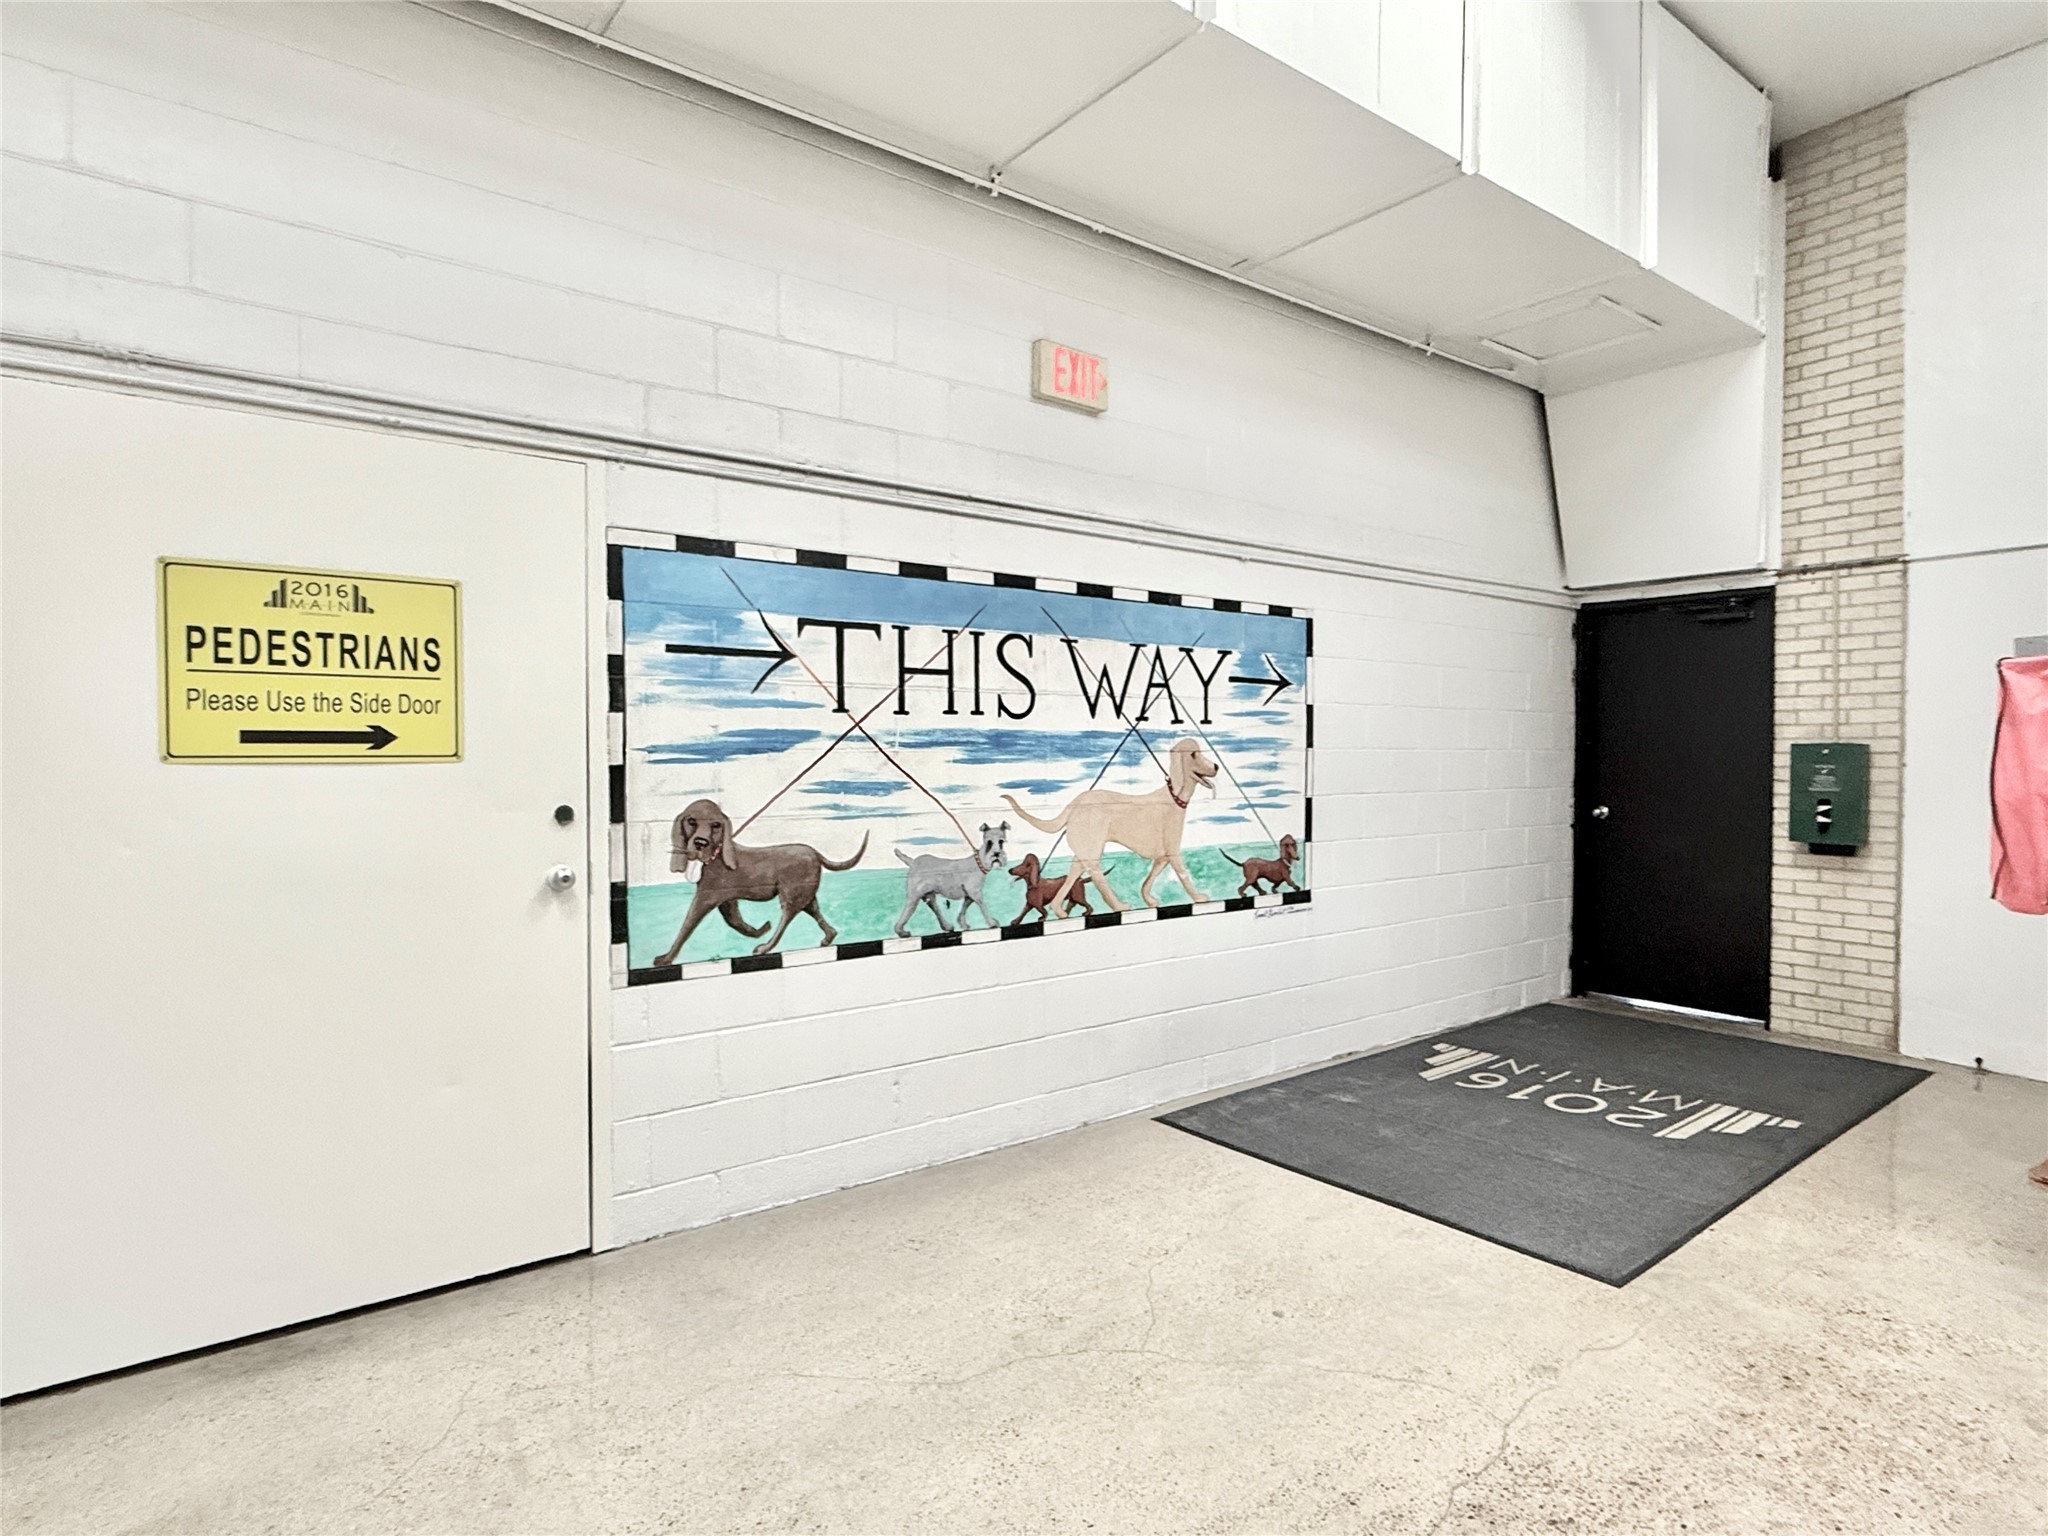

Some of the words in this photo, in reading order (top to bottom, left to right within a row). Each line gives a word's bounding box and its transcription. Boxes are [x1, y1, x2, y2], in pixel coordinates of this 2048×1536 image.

[1053, 347, 1100, 401] EXIT
[290, 580, 349, 599] 2016
[185, 624, 442, 672] PEDESTRIANS
[797, 617, 1036, 720] THIS
[1060, 638, 1233, 724] WAY
[185, 687, 259, 712] Please
[266, 690, 306, 713] Use
[312, 691, 343, 714] the
[349, 691, 392, 715] Side
[399, 693, 442, 716] Door
[1454, 1072, 1668, 1129] 2016
